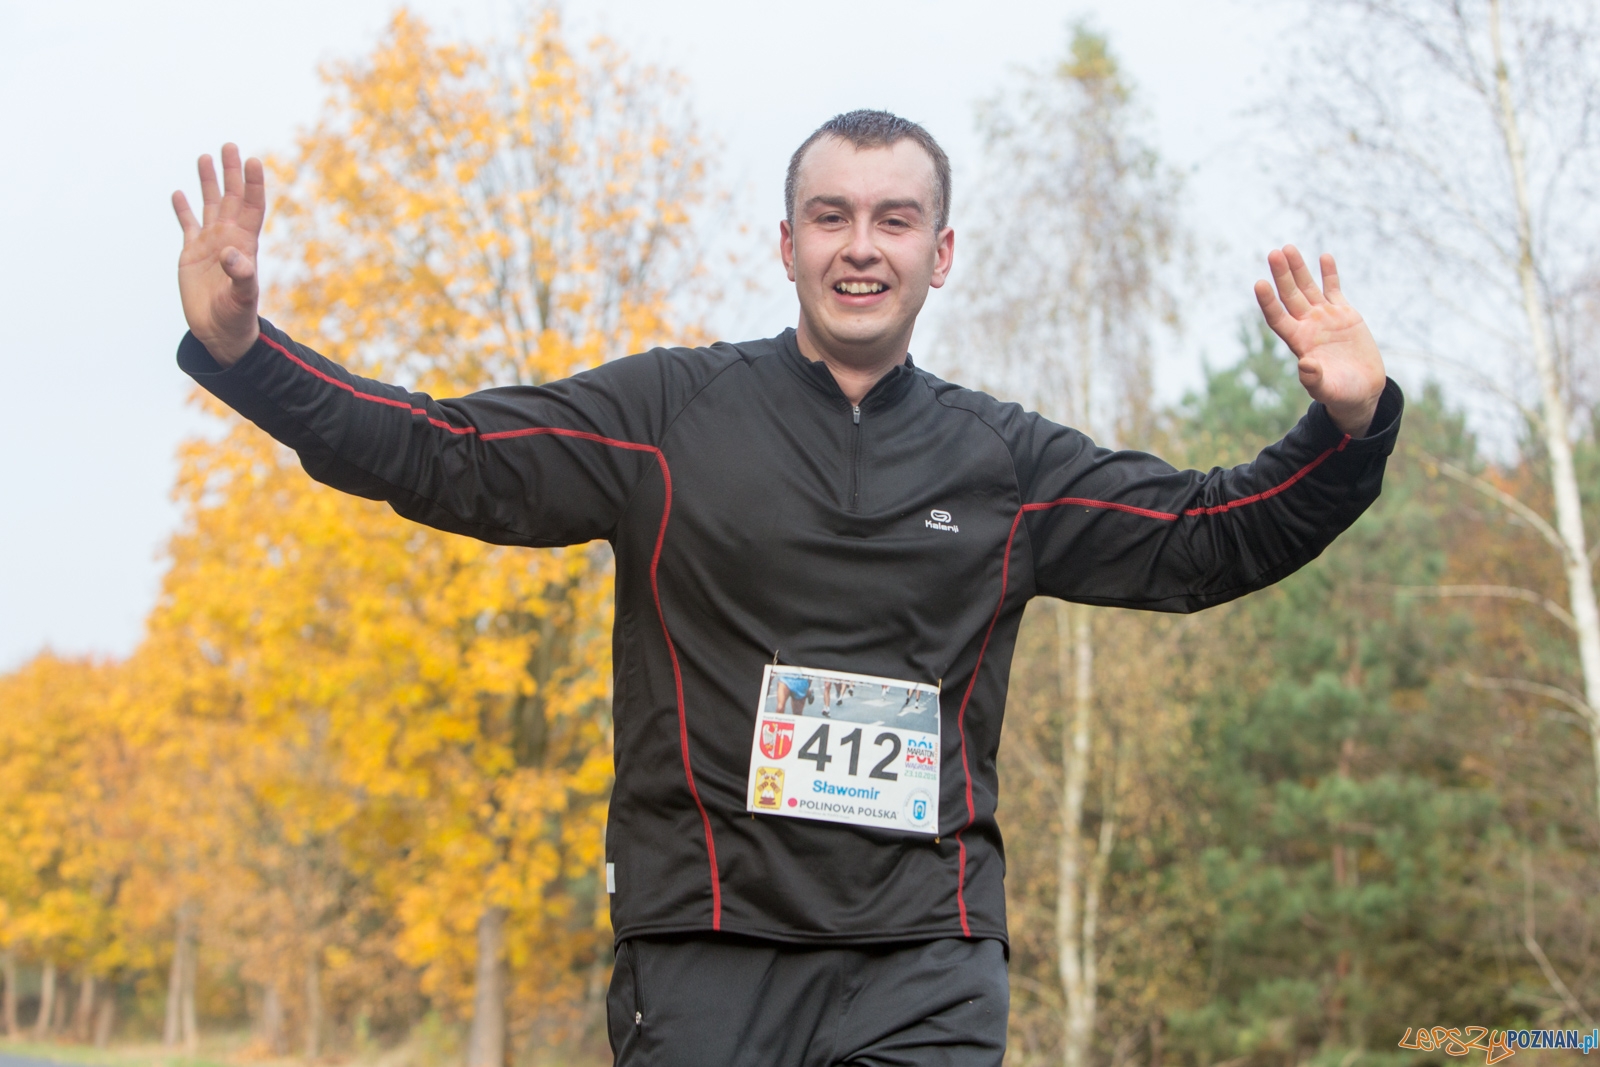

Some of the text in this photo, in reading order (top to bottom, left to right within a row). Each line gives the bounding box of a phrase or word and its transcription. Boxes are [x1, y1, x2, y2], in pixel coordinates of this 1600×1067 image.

[925, 519, 959, 533] Kalenji
[797, 723, 902, 782] 412
[906, 747, 935, 758] MARATON
[812, 779, 881, 800] Sławomir
[799, 799, 855, 815] POLINOVA
[857, 806, 898, 820] POLSKA
